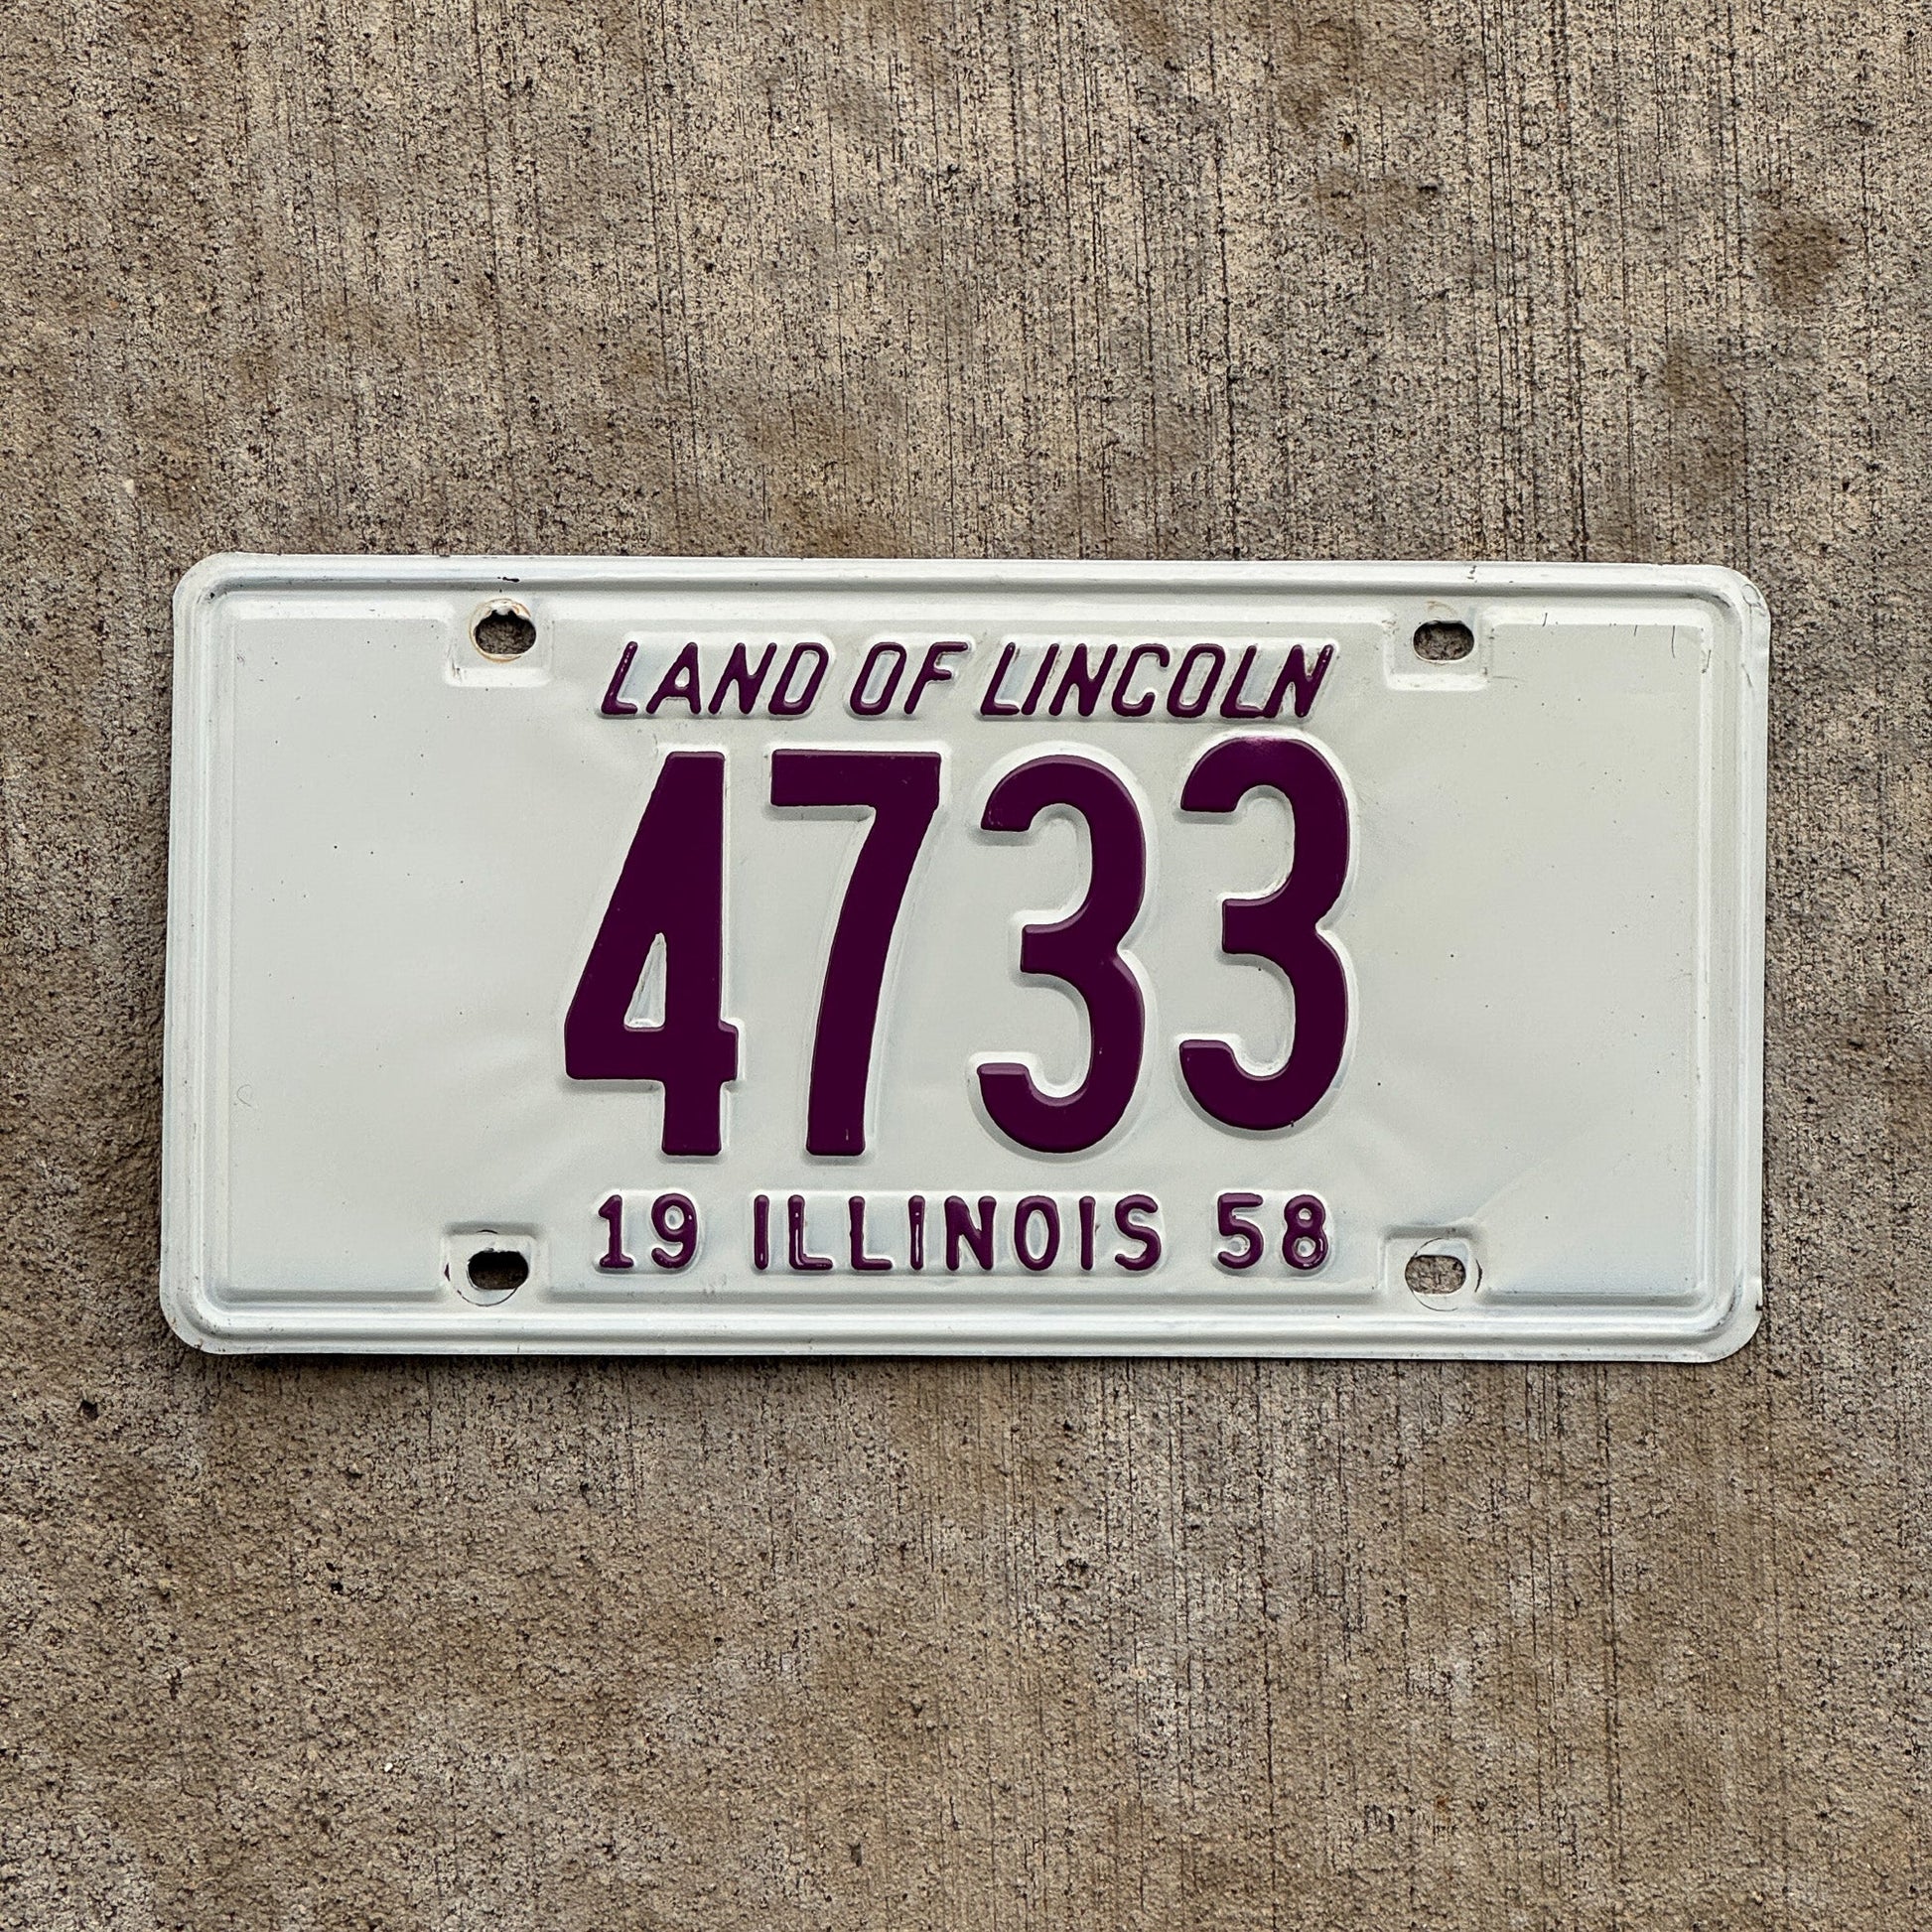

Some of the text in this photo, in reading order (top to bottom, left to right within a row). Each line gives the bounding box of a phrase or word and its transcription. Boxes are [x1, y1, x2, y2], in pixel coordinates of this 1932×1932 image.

[600, 640, 1334, 720] LAND OF LINCOLN
[564, 736, 1351, 1157] 4733
[598, 1192, 1330, 1273] 19 ILLINOIS 58
